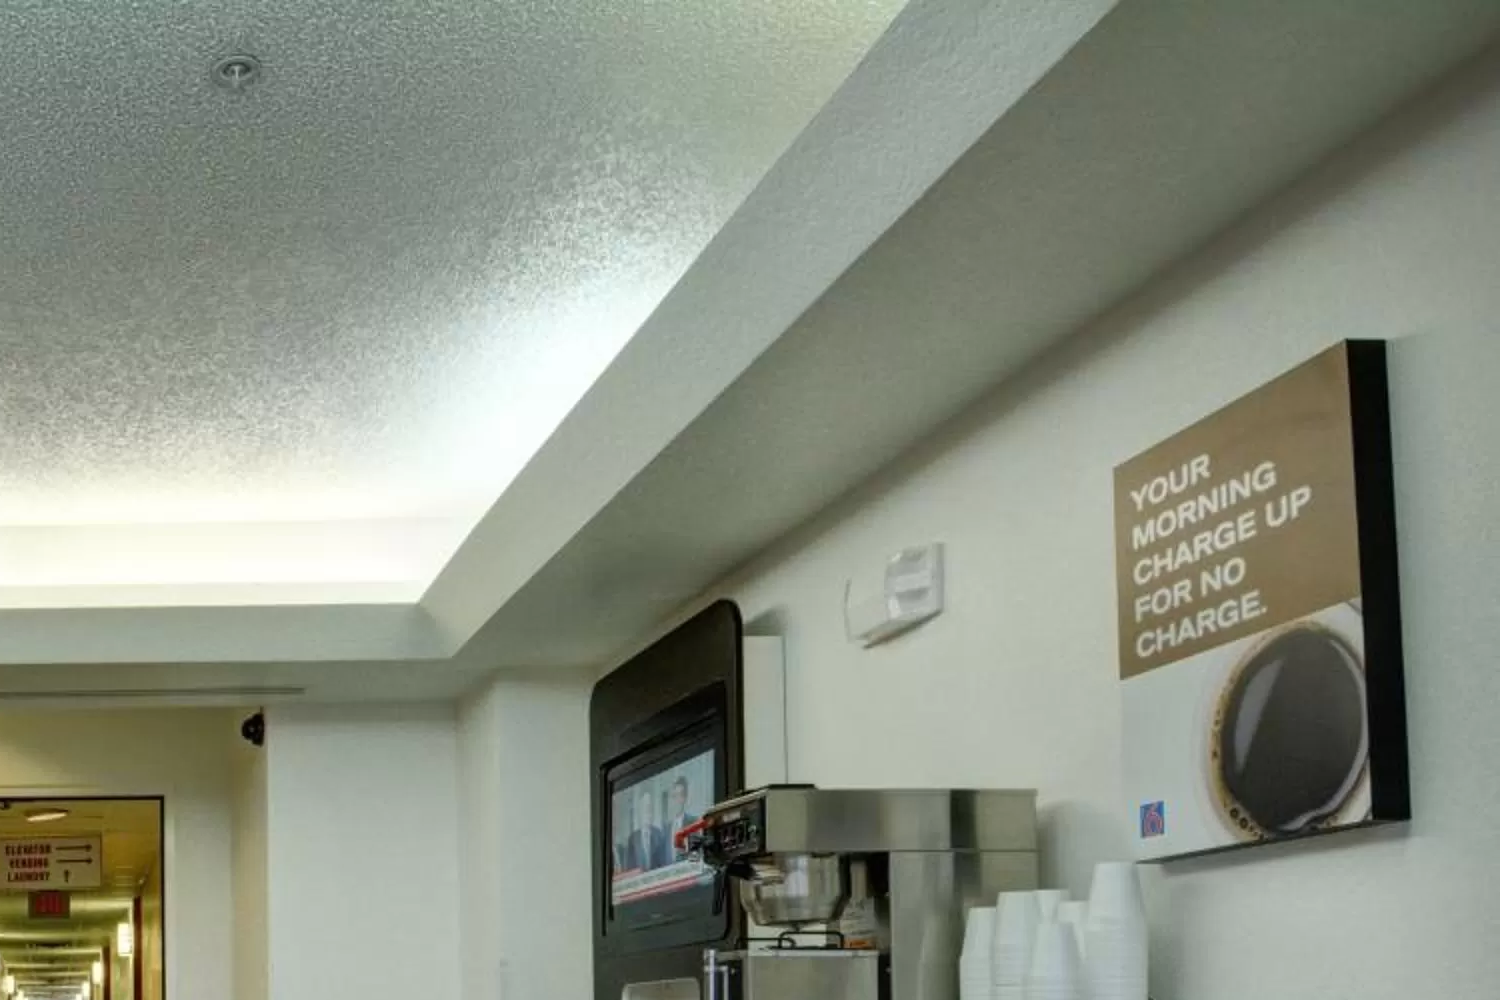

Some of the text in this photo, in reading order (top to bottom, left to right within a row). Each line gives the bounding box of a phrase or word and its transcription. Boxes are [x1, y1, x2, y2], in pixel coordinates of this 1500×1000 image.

[1130, 453, 1211, 512] YOUR
[1132, 461, 1277, 550] MORNING
[1133, 485, 1312, 585] CHARGE UP
[1134, 556, 1246, 623] FOR NO
[1135, 589, 1268, 658] CHARGE.
[5, 844, 52, 856] ELEVATOR
[7, 871, 50, 882] LAUNDRY
[9, 857, 49, 869] VENDING
